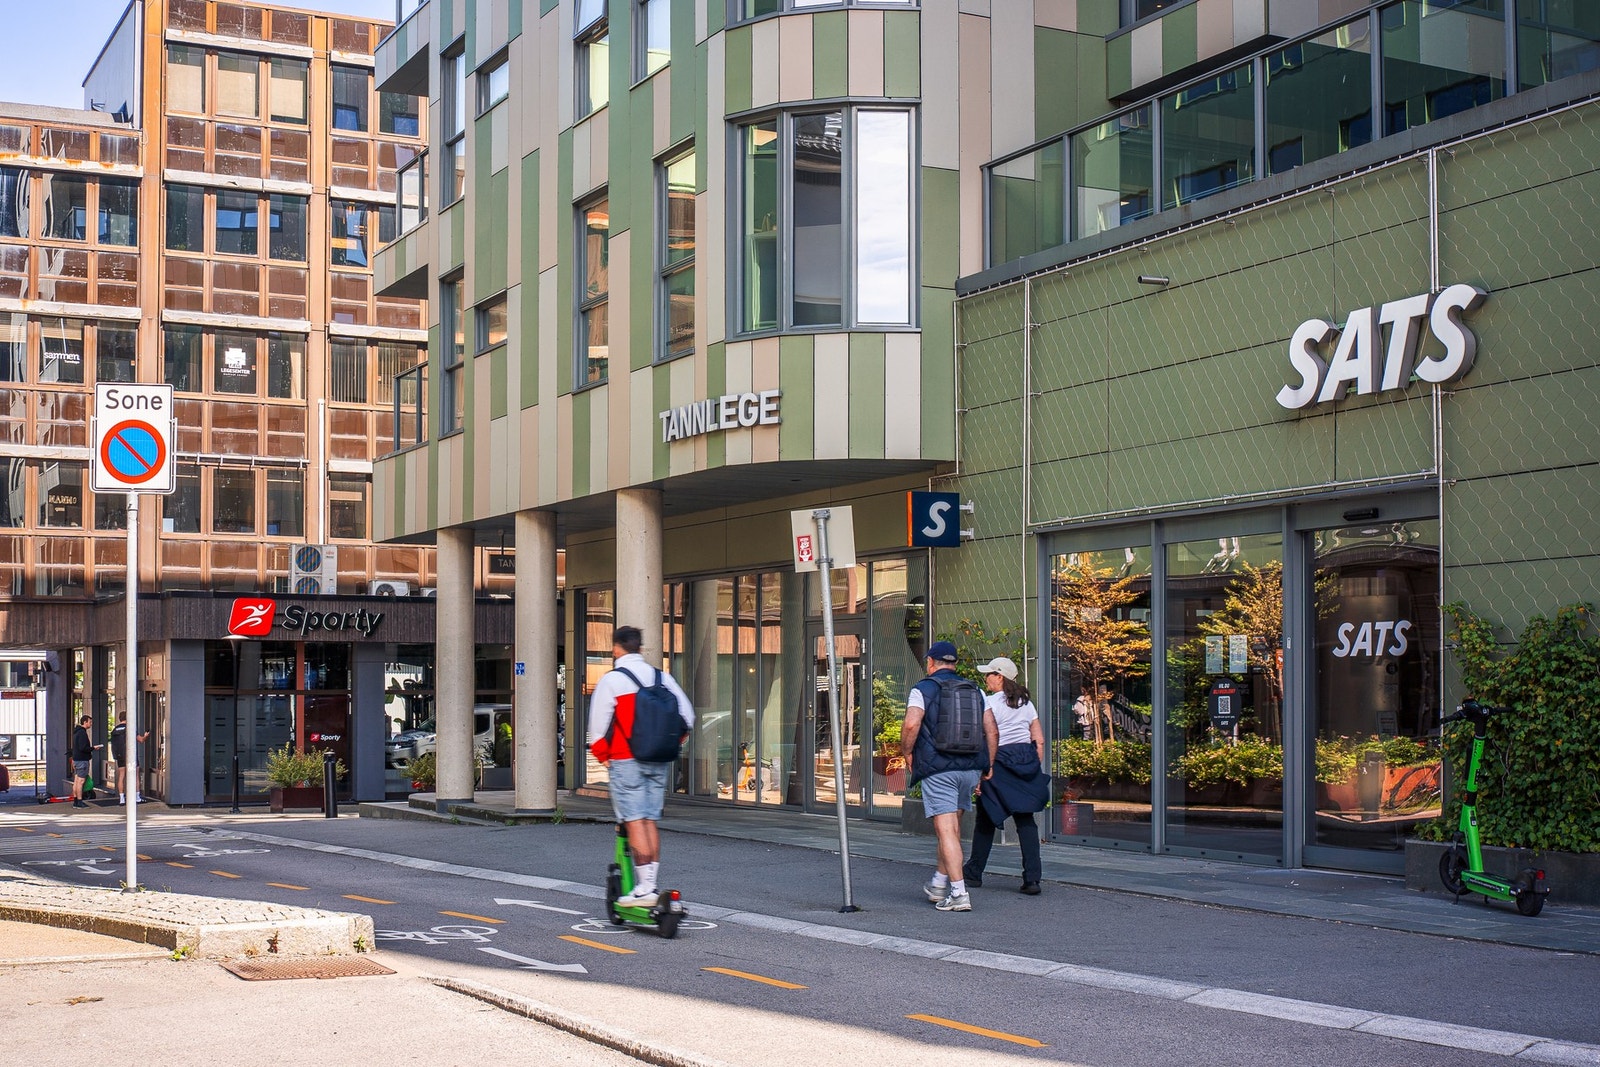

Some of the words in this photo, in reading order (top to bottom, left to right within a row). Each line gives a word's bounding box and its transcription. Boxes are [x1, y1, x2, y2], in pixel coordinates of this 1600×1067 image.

[1276, 284, 1482, 409] SATS
[105, 389, 163, 410] Sone
[659, 389, 781, 443] TANNLEGE
[922, 501, 951, 537] S
[282, 604, 384, 637] Sporty
[1332, 620, 1412, 657] SATS
